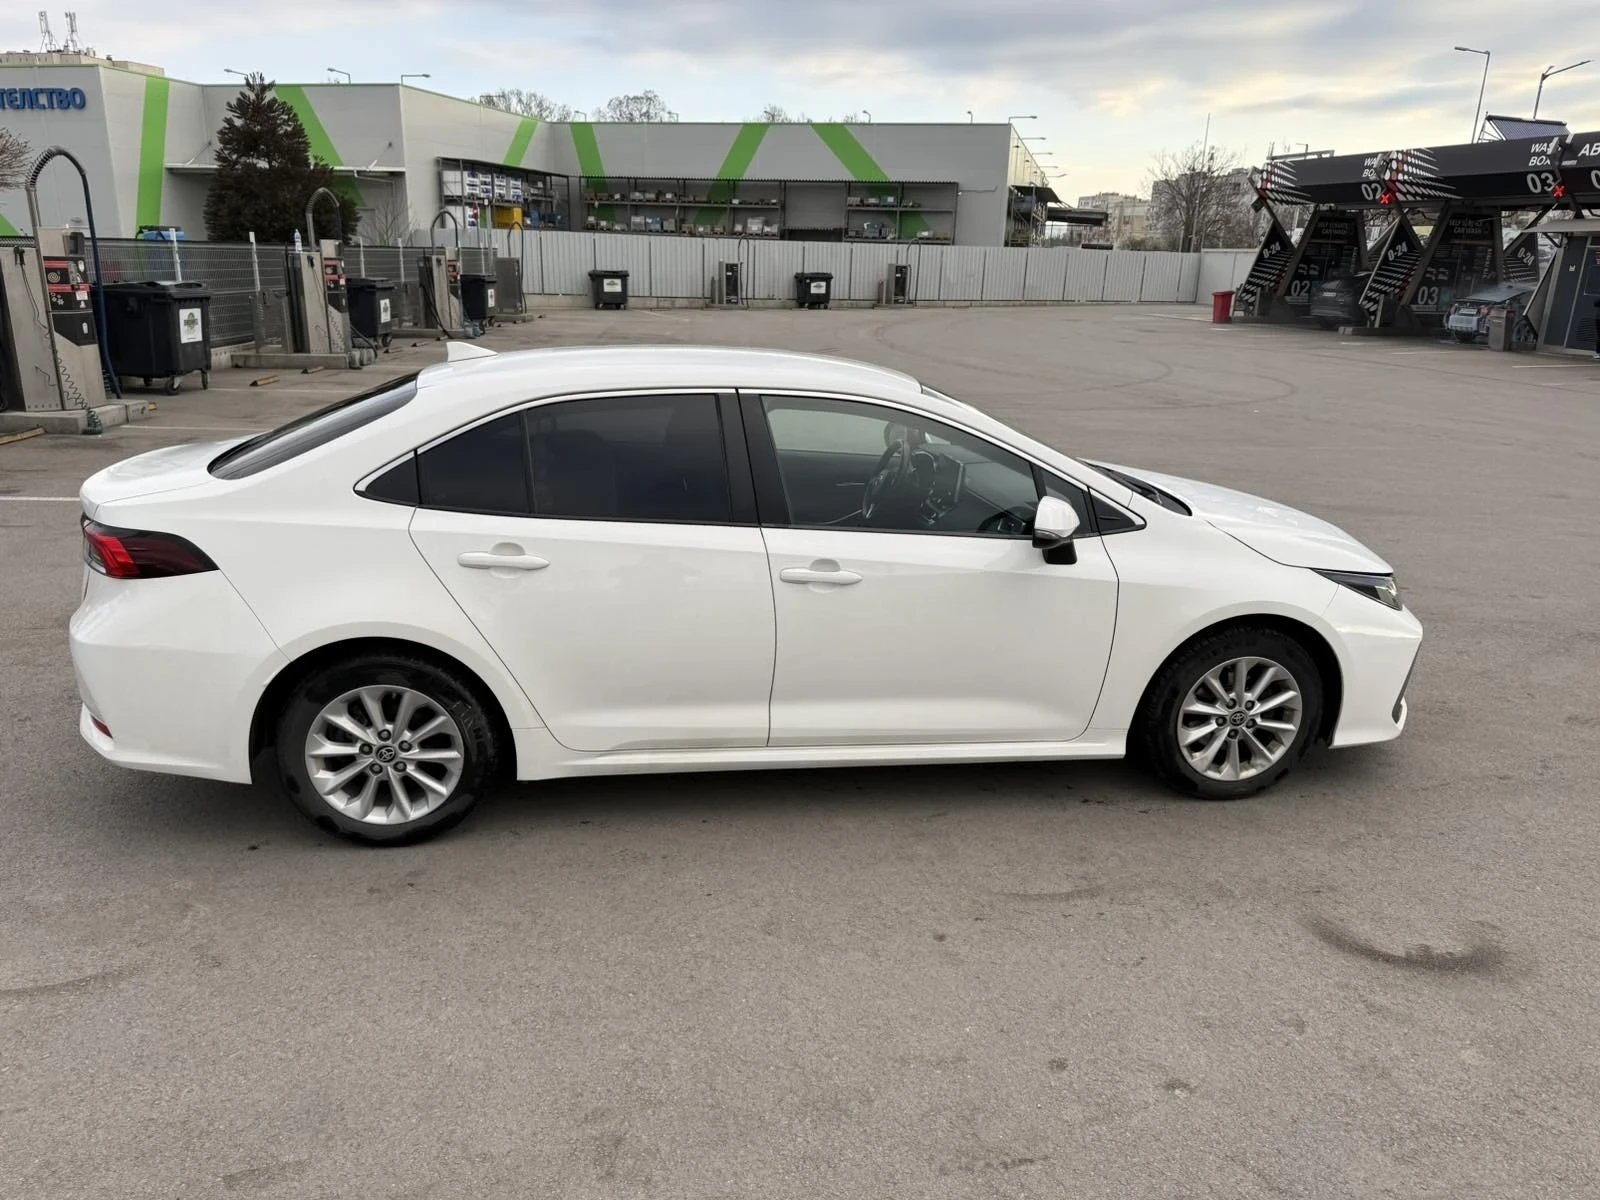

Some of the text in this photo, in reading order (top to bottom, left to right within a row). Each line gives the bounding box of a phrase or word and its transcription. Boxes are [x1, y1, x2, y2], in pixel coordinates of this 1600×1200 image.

[1526, 172, 1556, 194] 03
[1263, 241, 1281, 259] 0-24
[1387, 241, 1408, 261] 0-24
[1291, 280, 1310, 297] 02
[1417, 286, 1438, 305] 03
